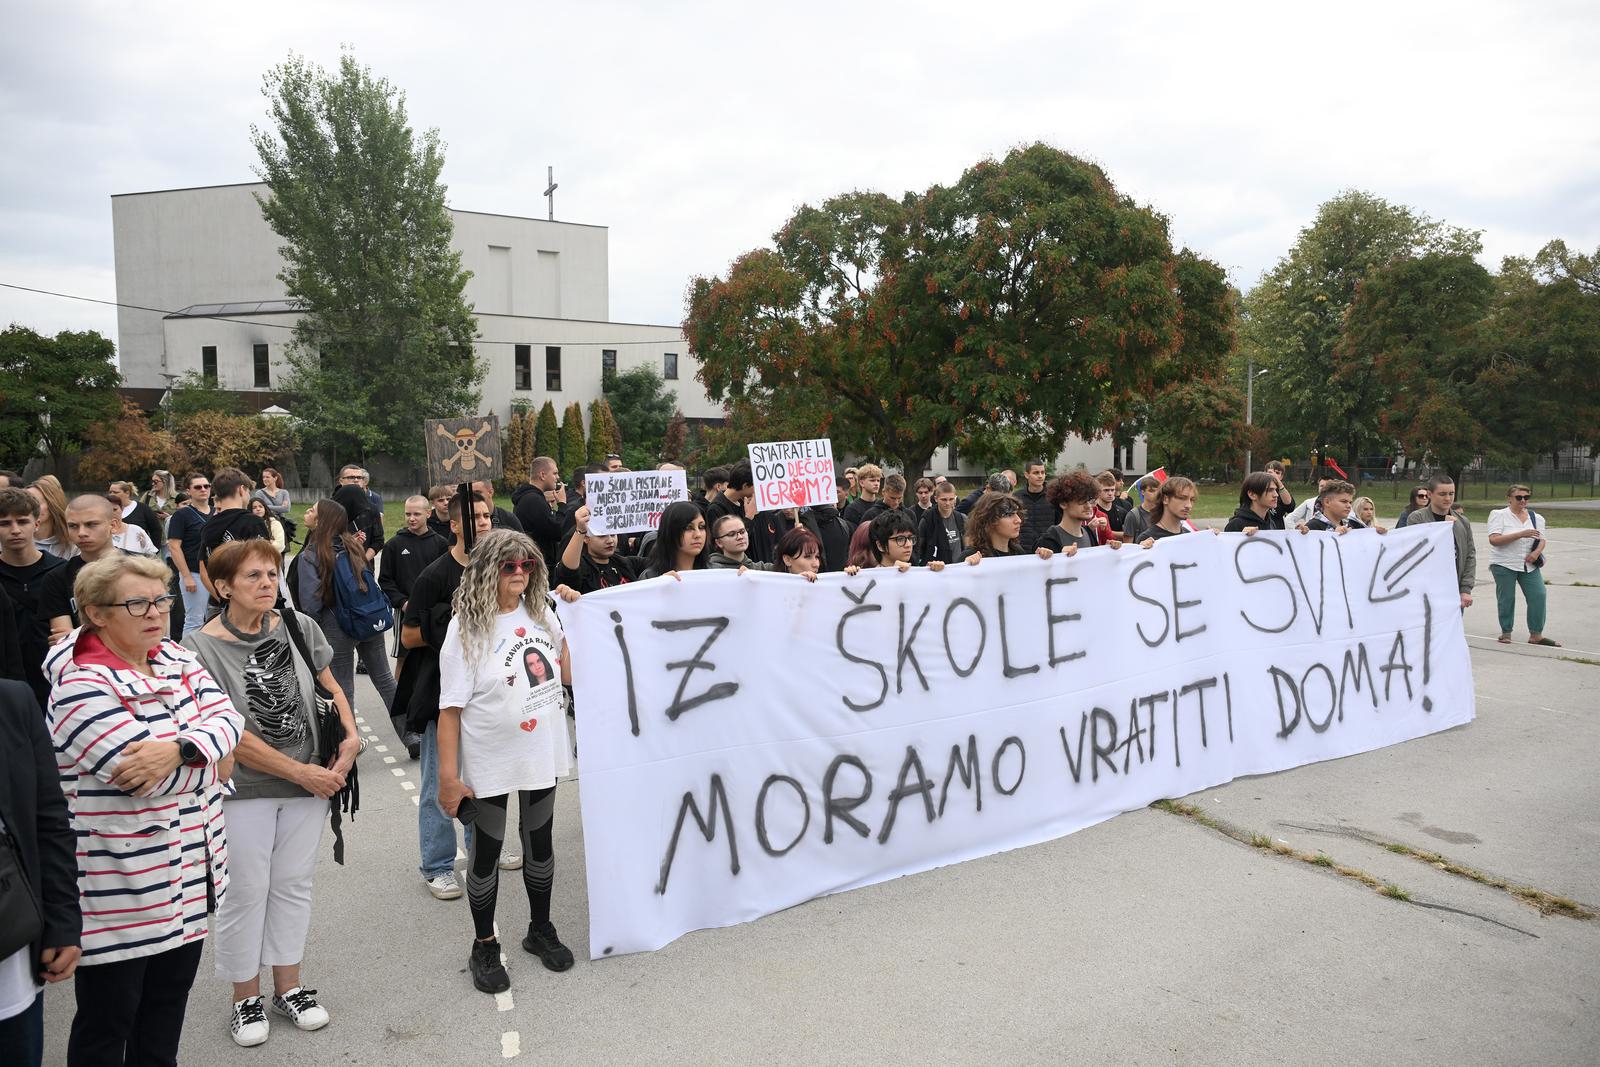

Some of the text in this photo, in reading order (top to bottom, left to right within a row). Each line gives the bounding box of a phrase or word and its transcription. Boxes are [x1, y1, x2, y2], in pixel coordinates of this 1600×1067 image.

[752, 441, 826, 463] SMATRATE LI
[756, 458, 832, 481] OVO DJEČJOM
[588, 480, 604, 493] KAD
[607, 476, 633, 492] ŠKOLA
[596, 493, 626, 507] MJESTO
[593, 506, 603, 517] SE
[837, 579, 1087, 712] ŠKOLE
[1128, 561, 1207, 648] SE
[1234, 536, 1354, 635] SVI
[504, 641, 524, 667] PRAVDA
[524, 637, 534, 645] ZA
[655, 592, 1434, 895] MORAMO VRATITI DOMA!
